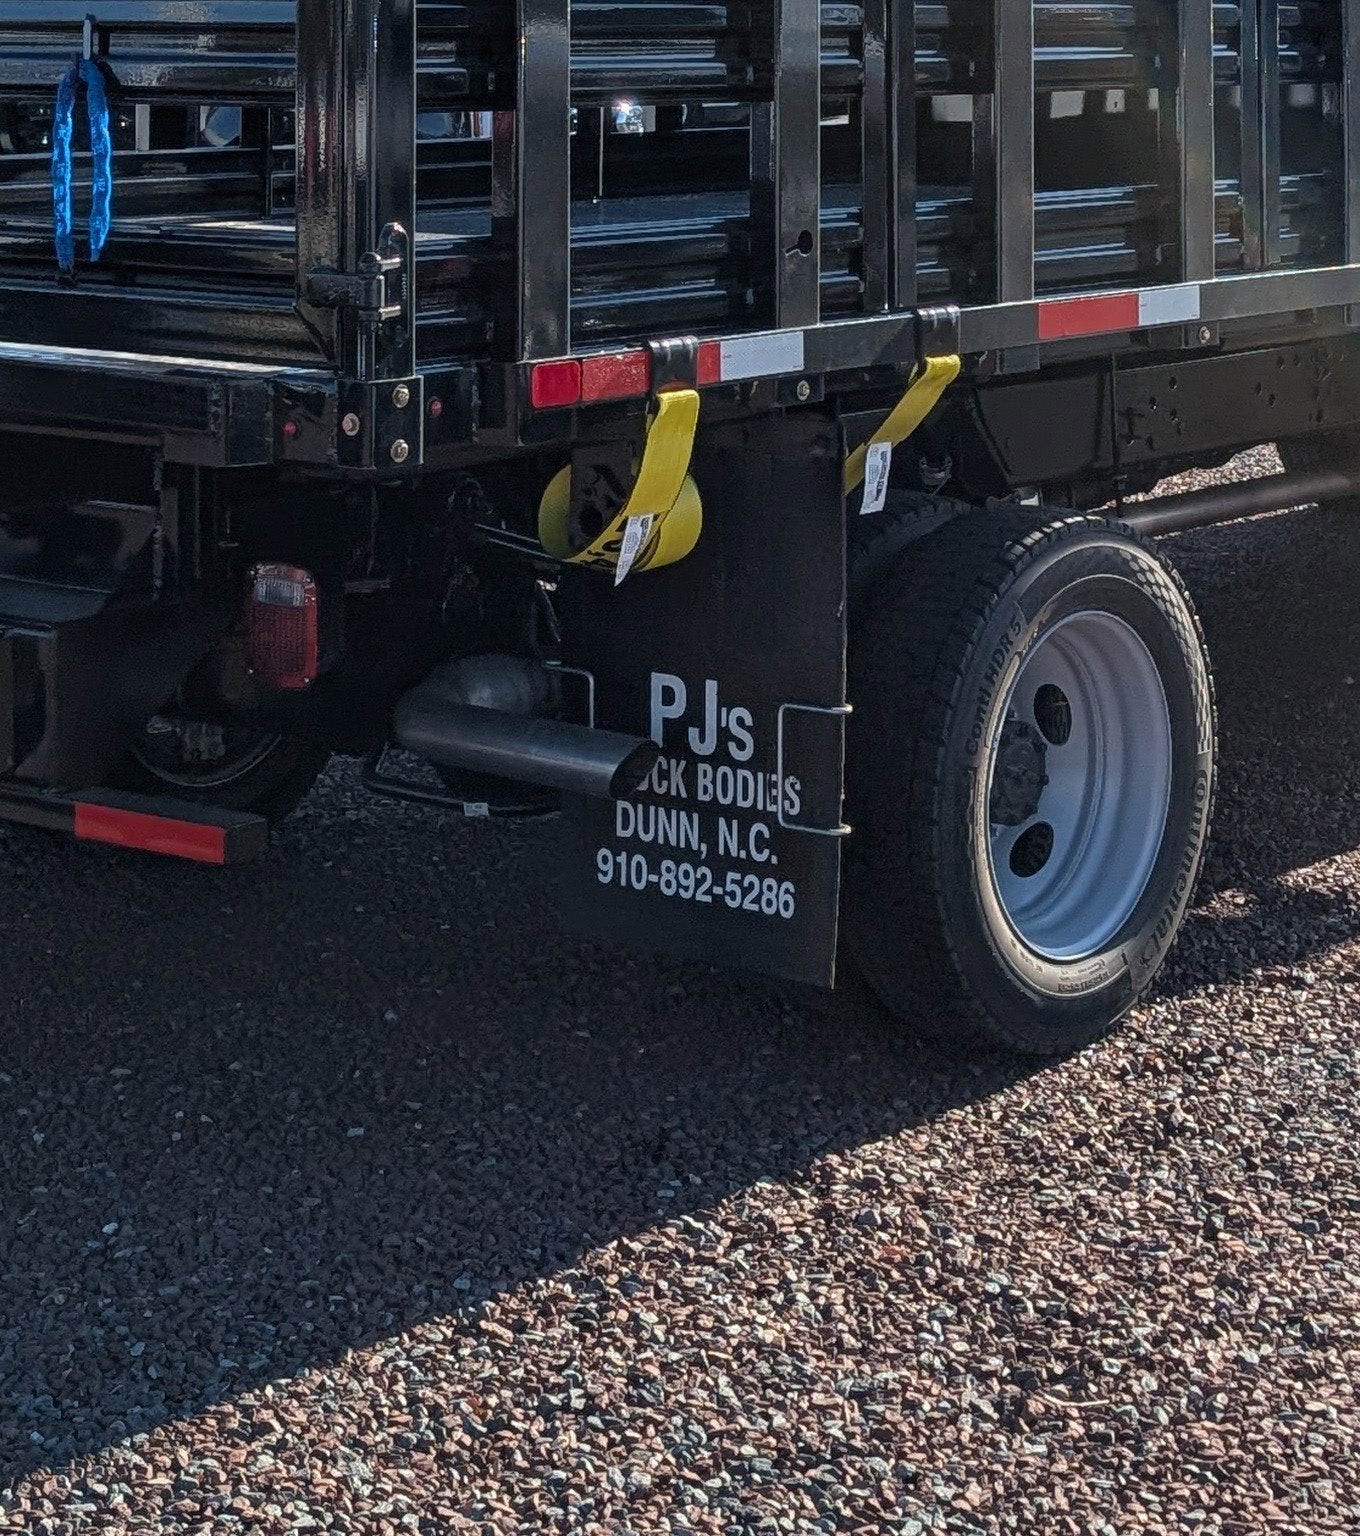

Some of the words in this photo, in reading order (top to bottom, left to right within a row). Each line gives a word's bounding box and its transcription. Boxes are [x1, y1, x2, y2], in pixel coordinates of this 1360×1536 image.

[697, 763, 801, 816] BODIES
[615, 799, 708, 860] DUNN,
[718, 816, 779, 865] N.C.
[596, 847, 796, 919] 910-892-5286
